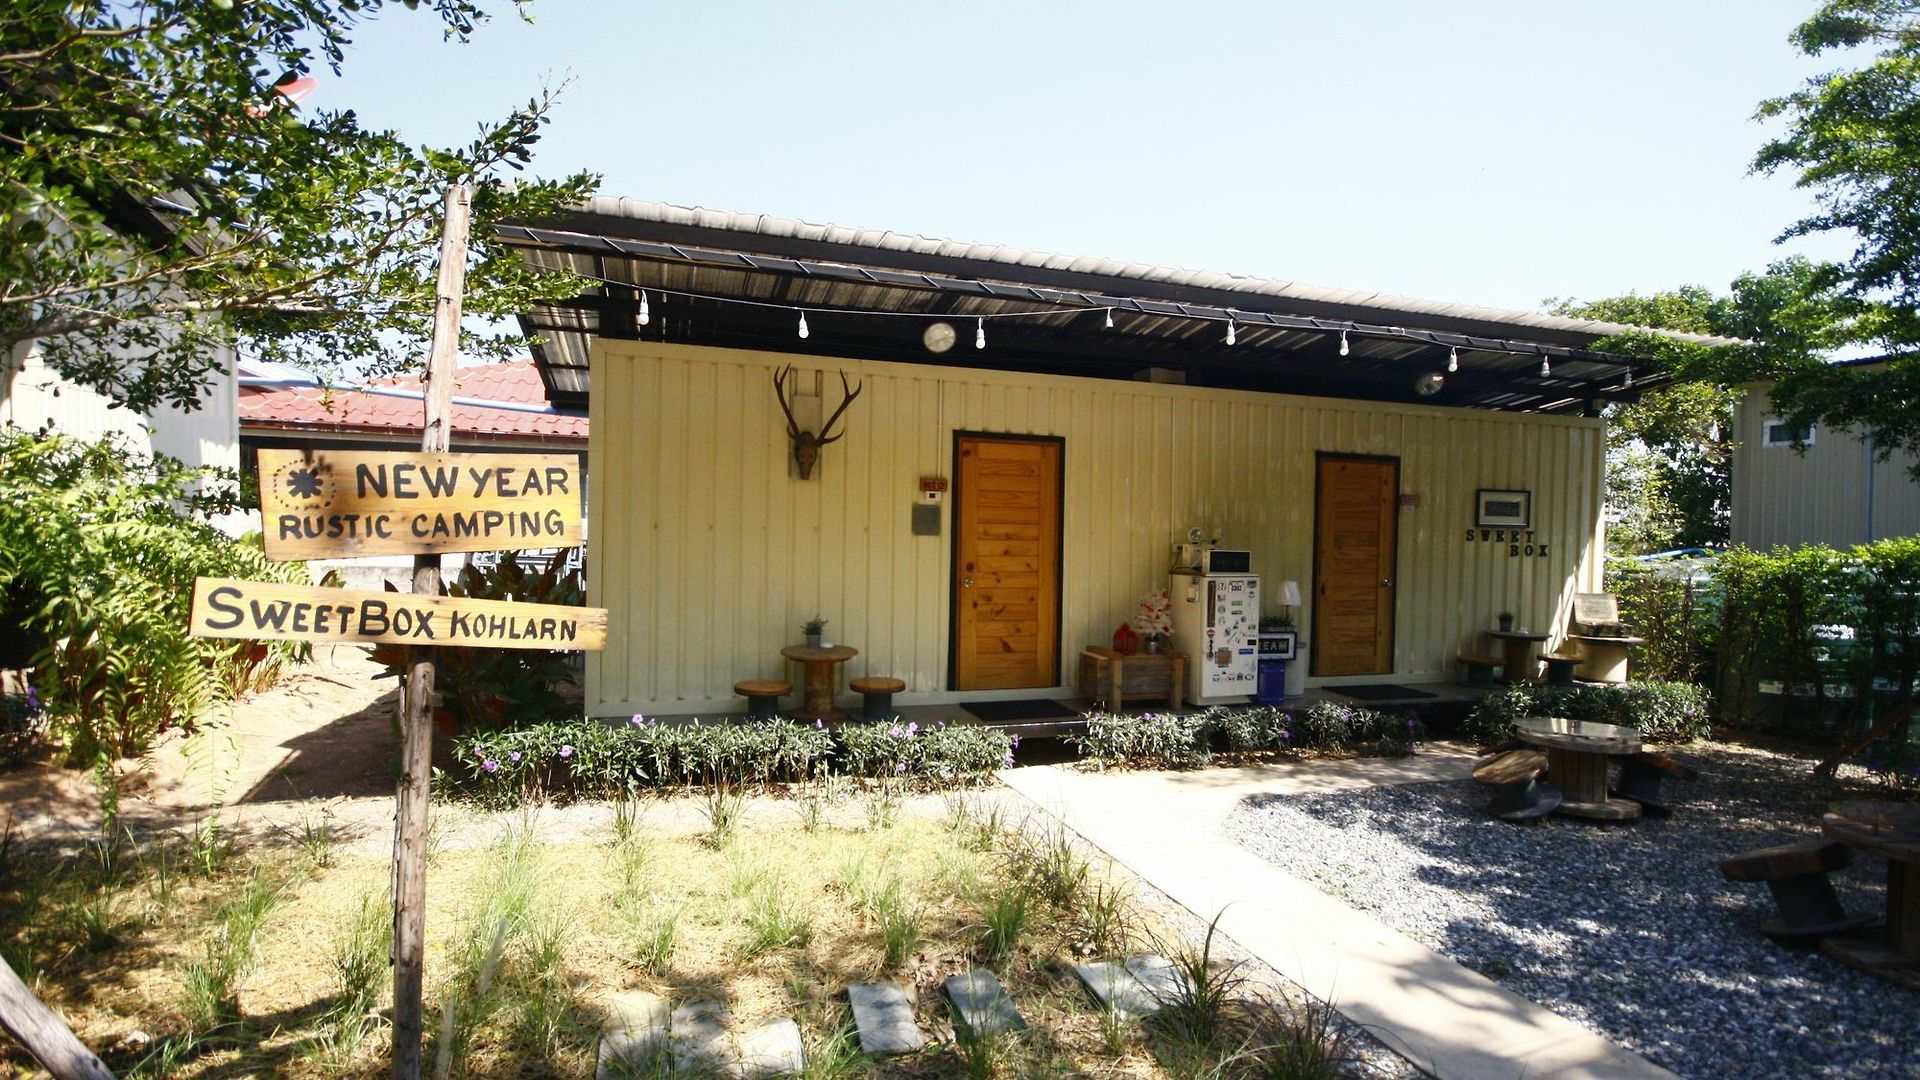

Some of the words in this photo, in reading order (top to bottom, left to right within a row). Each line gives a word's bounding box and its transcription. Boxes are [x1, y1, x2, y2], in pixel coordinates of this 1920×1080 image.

[356, 463, 459, 499] NEW
[467, 467, 570, 497] YEAR
[278, 514, 392, 540] RUSTIC
[411, 509, 565, 539] CAMPING
[1466, 529, 1534, 543] SWEET
[1510, 545, 1548, 557] BOX
[450, 610, 577, 642] KOHLARN
